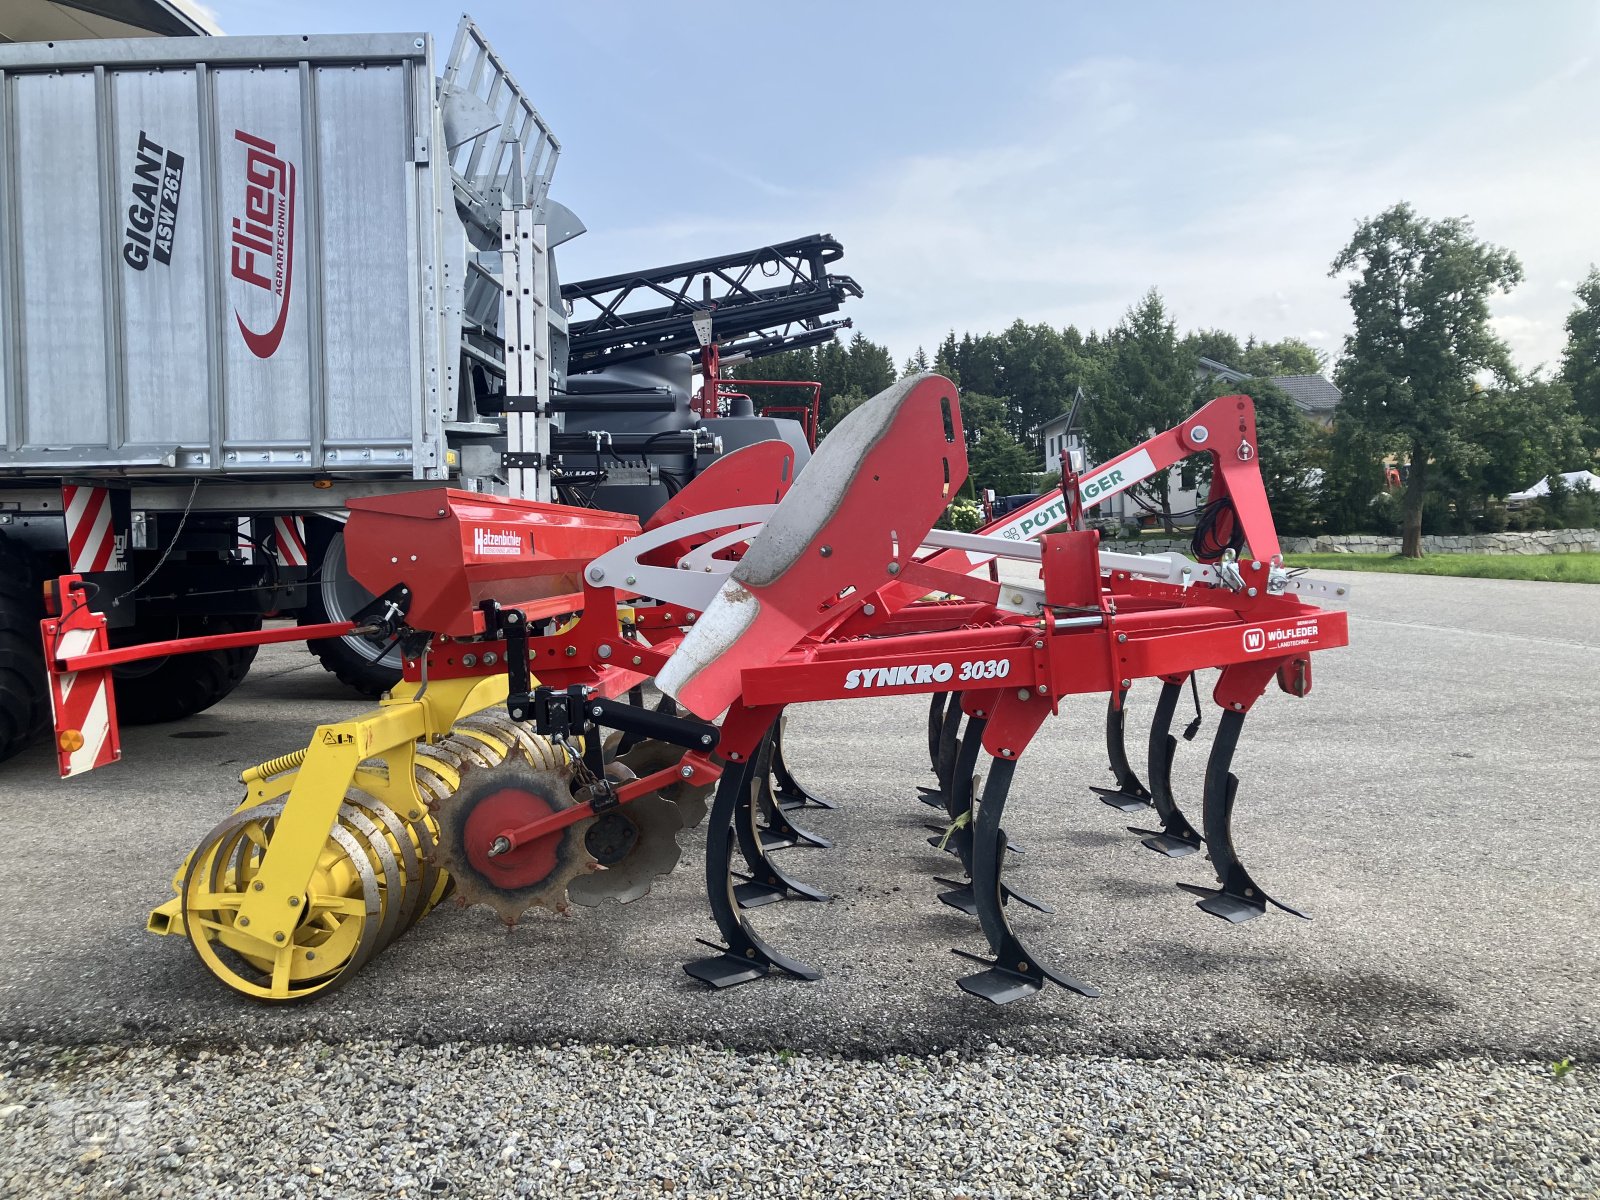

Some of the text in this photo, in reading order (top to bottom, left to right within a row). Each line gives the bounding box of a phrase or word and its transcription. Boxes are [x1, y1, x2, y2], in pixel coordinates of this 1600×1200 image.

[123, 129, 164, 271] GIGANT
[158, 167, 181, 255] ASW 261
[231, 128, 288, 291] Fliegl
[275, 197, 287, 298] AGRARTECHNIK
[1019, 469, 1126, 535] PÖTTGER
[474, 528, 522, 555] Hatzenbichler
[1268, 626, 1319, 642] WÖLFLEDER
[1277, 639, 1310, 649] LANDTECHNIK
[844, 658, 1010, 690] SYNKRO 3030
